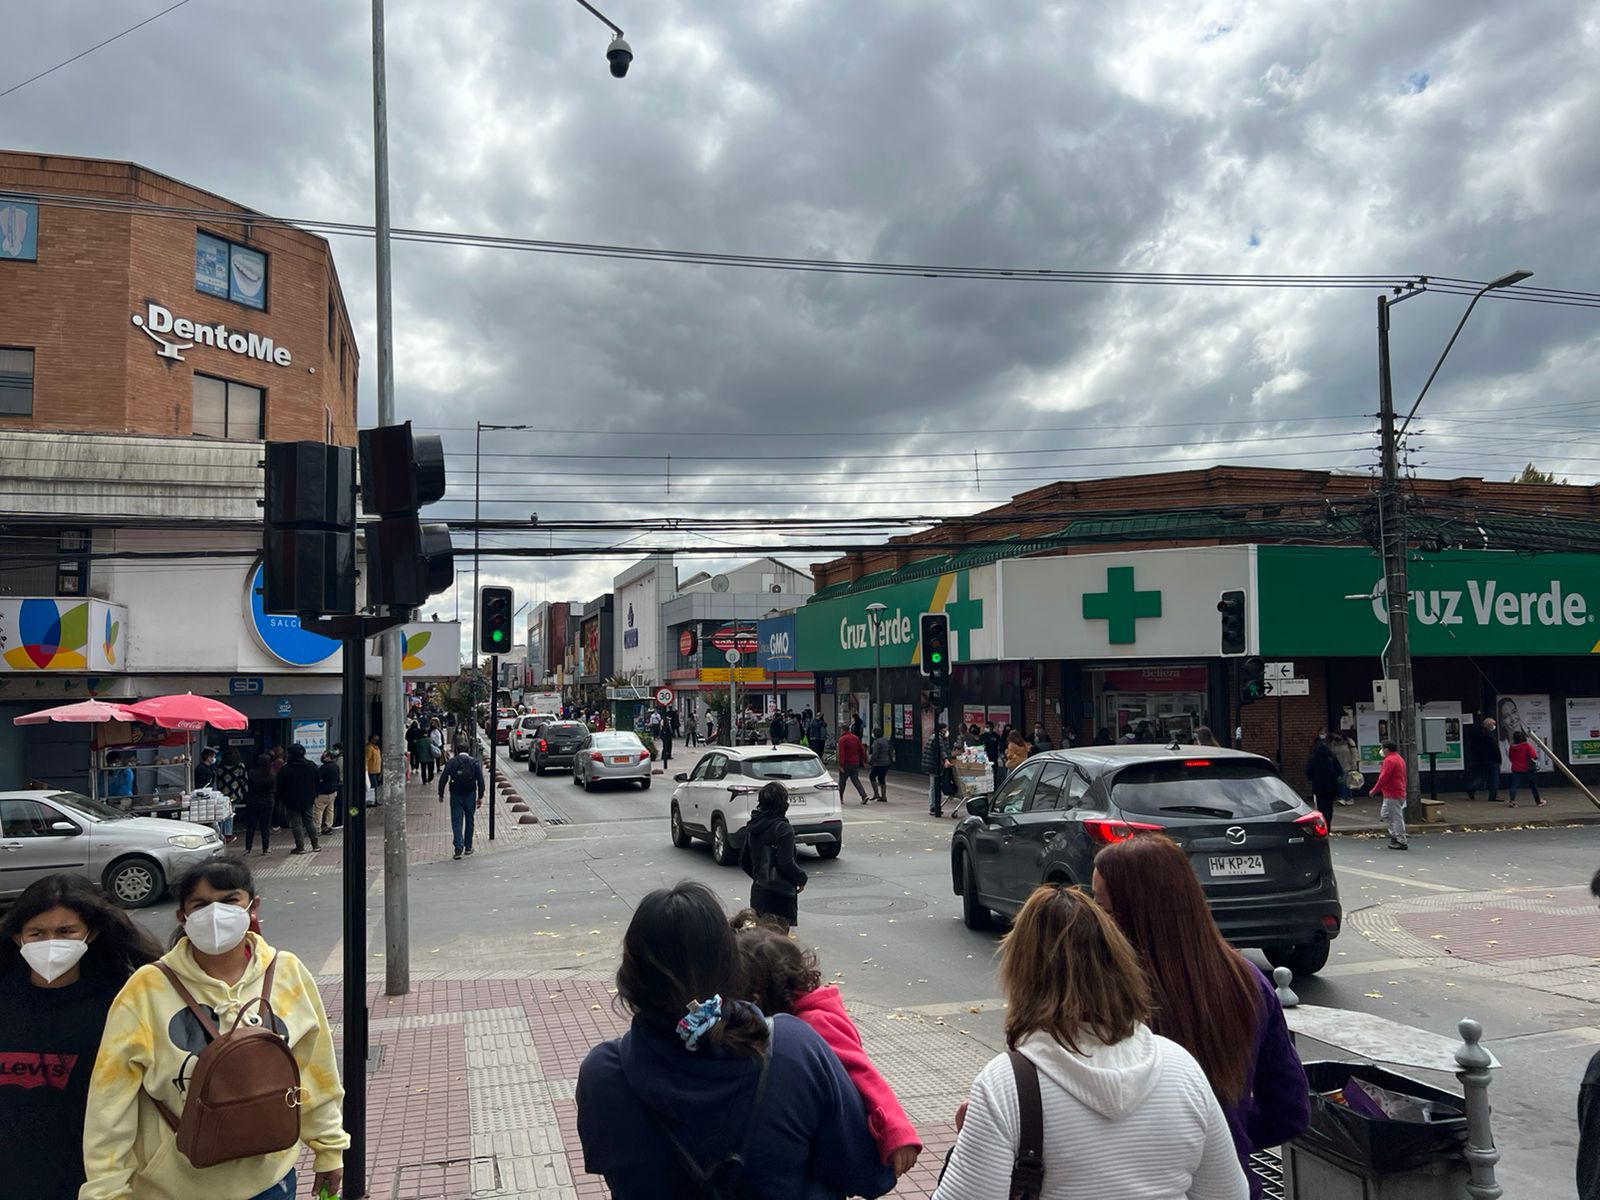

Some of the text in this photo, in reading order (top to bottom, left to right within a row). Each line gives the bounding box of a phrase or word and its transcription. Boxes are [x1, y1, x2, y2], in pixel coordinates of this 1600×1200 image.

[148, 303, 292, 367] DentoMe
[1466, 580, 1587, 626] Verde
[769, 631, 789, 655] GMO
[840, 607, 911, 650] Cruz Verde
[659, 692, 671, 701] 30
